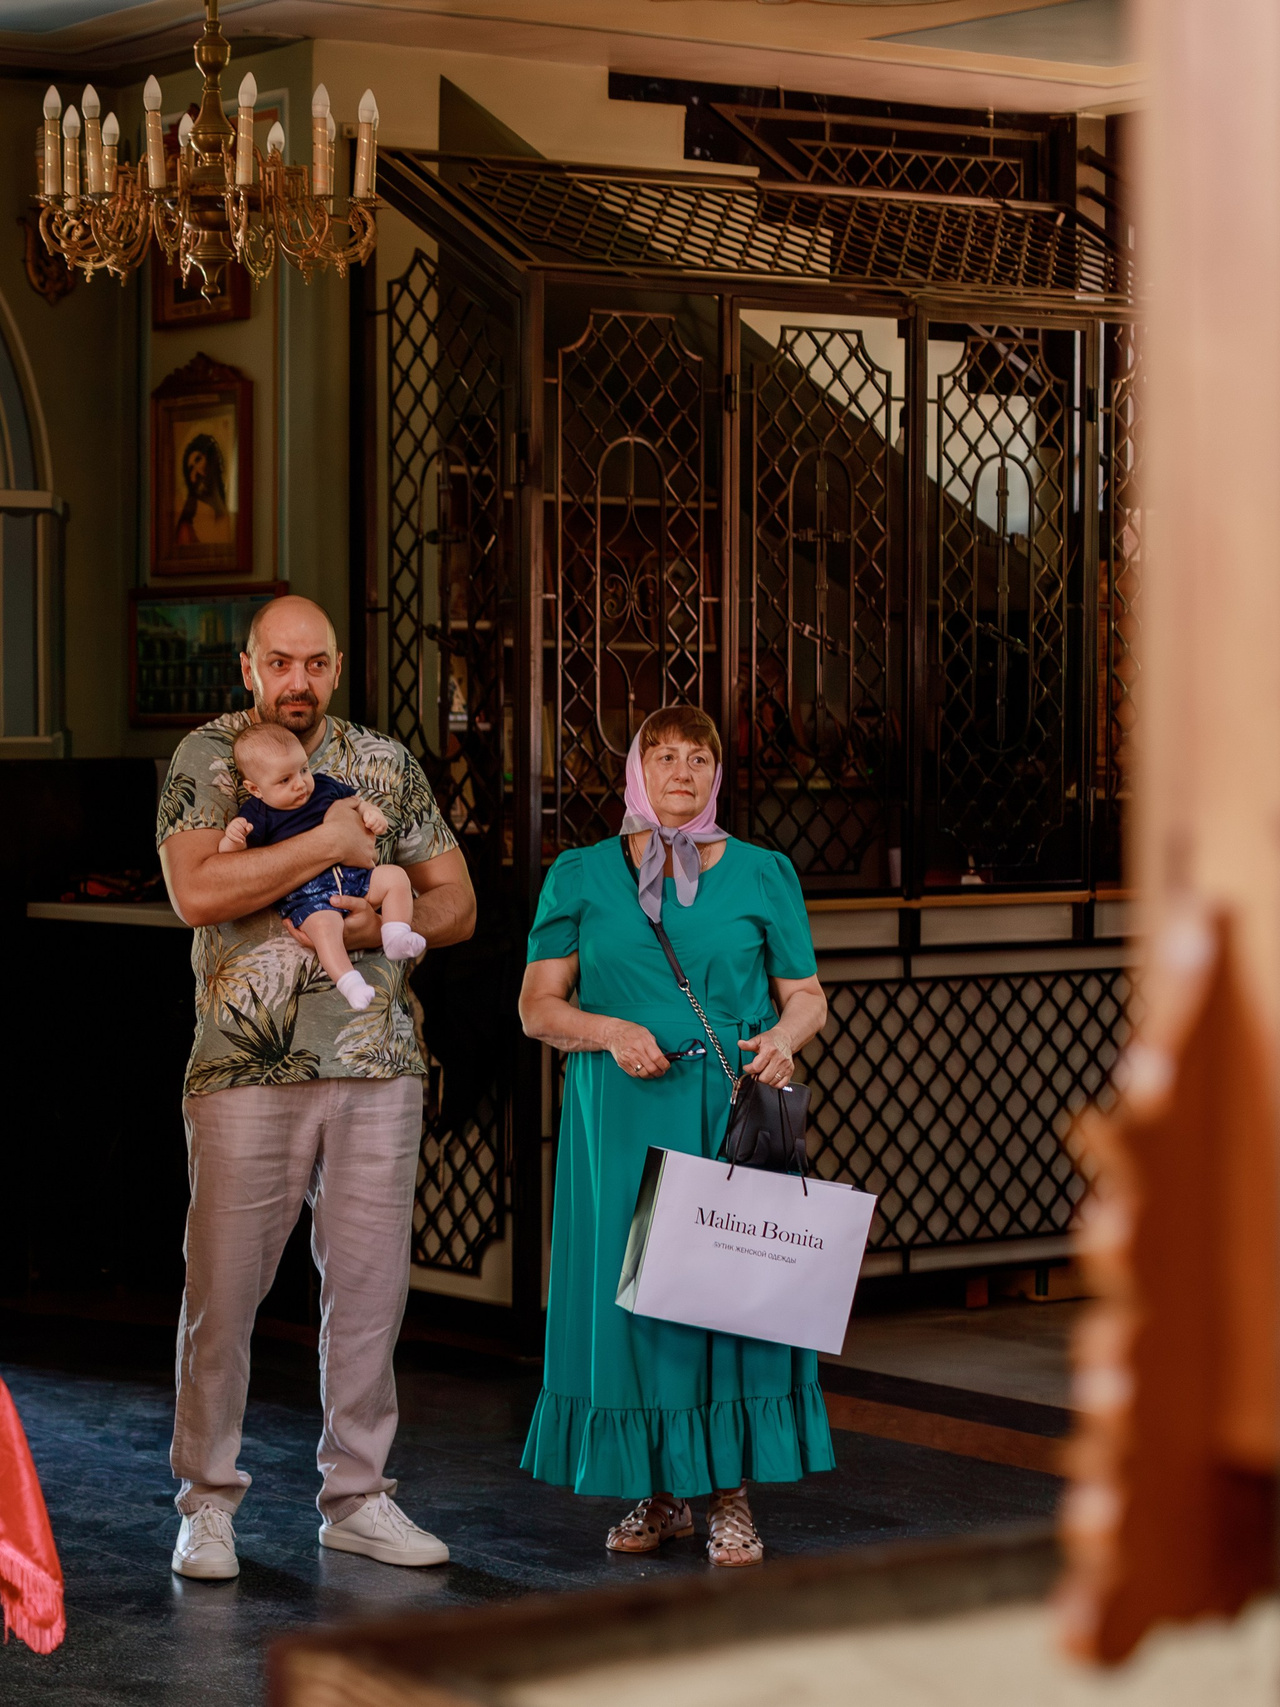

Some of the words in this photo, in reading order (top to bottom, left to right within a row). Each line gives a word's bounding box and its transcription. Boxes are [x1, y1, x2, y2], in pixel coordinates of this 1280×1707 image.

[694, 1206, 756, 1236] Malina
[760, 1220, 824, 1250] Bonita
[714, 1241, 734, 1251] БУТИК
[735, 1246, 766, 1258] ЖЕНСКОЙ
[768, 1252, 796, 1264] ОДЕЖДЫ
